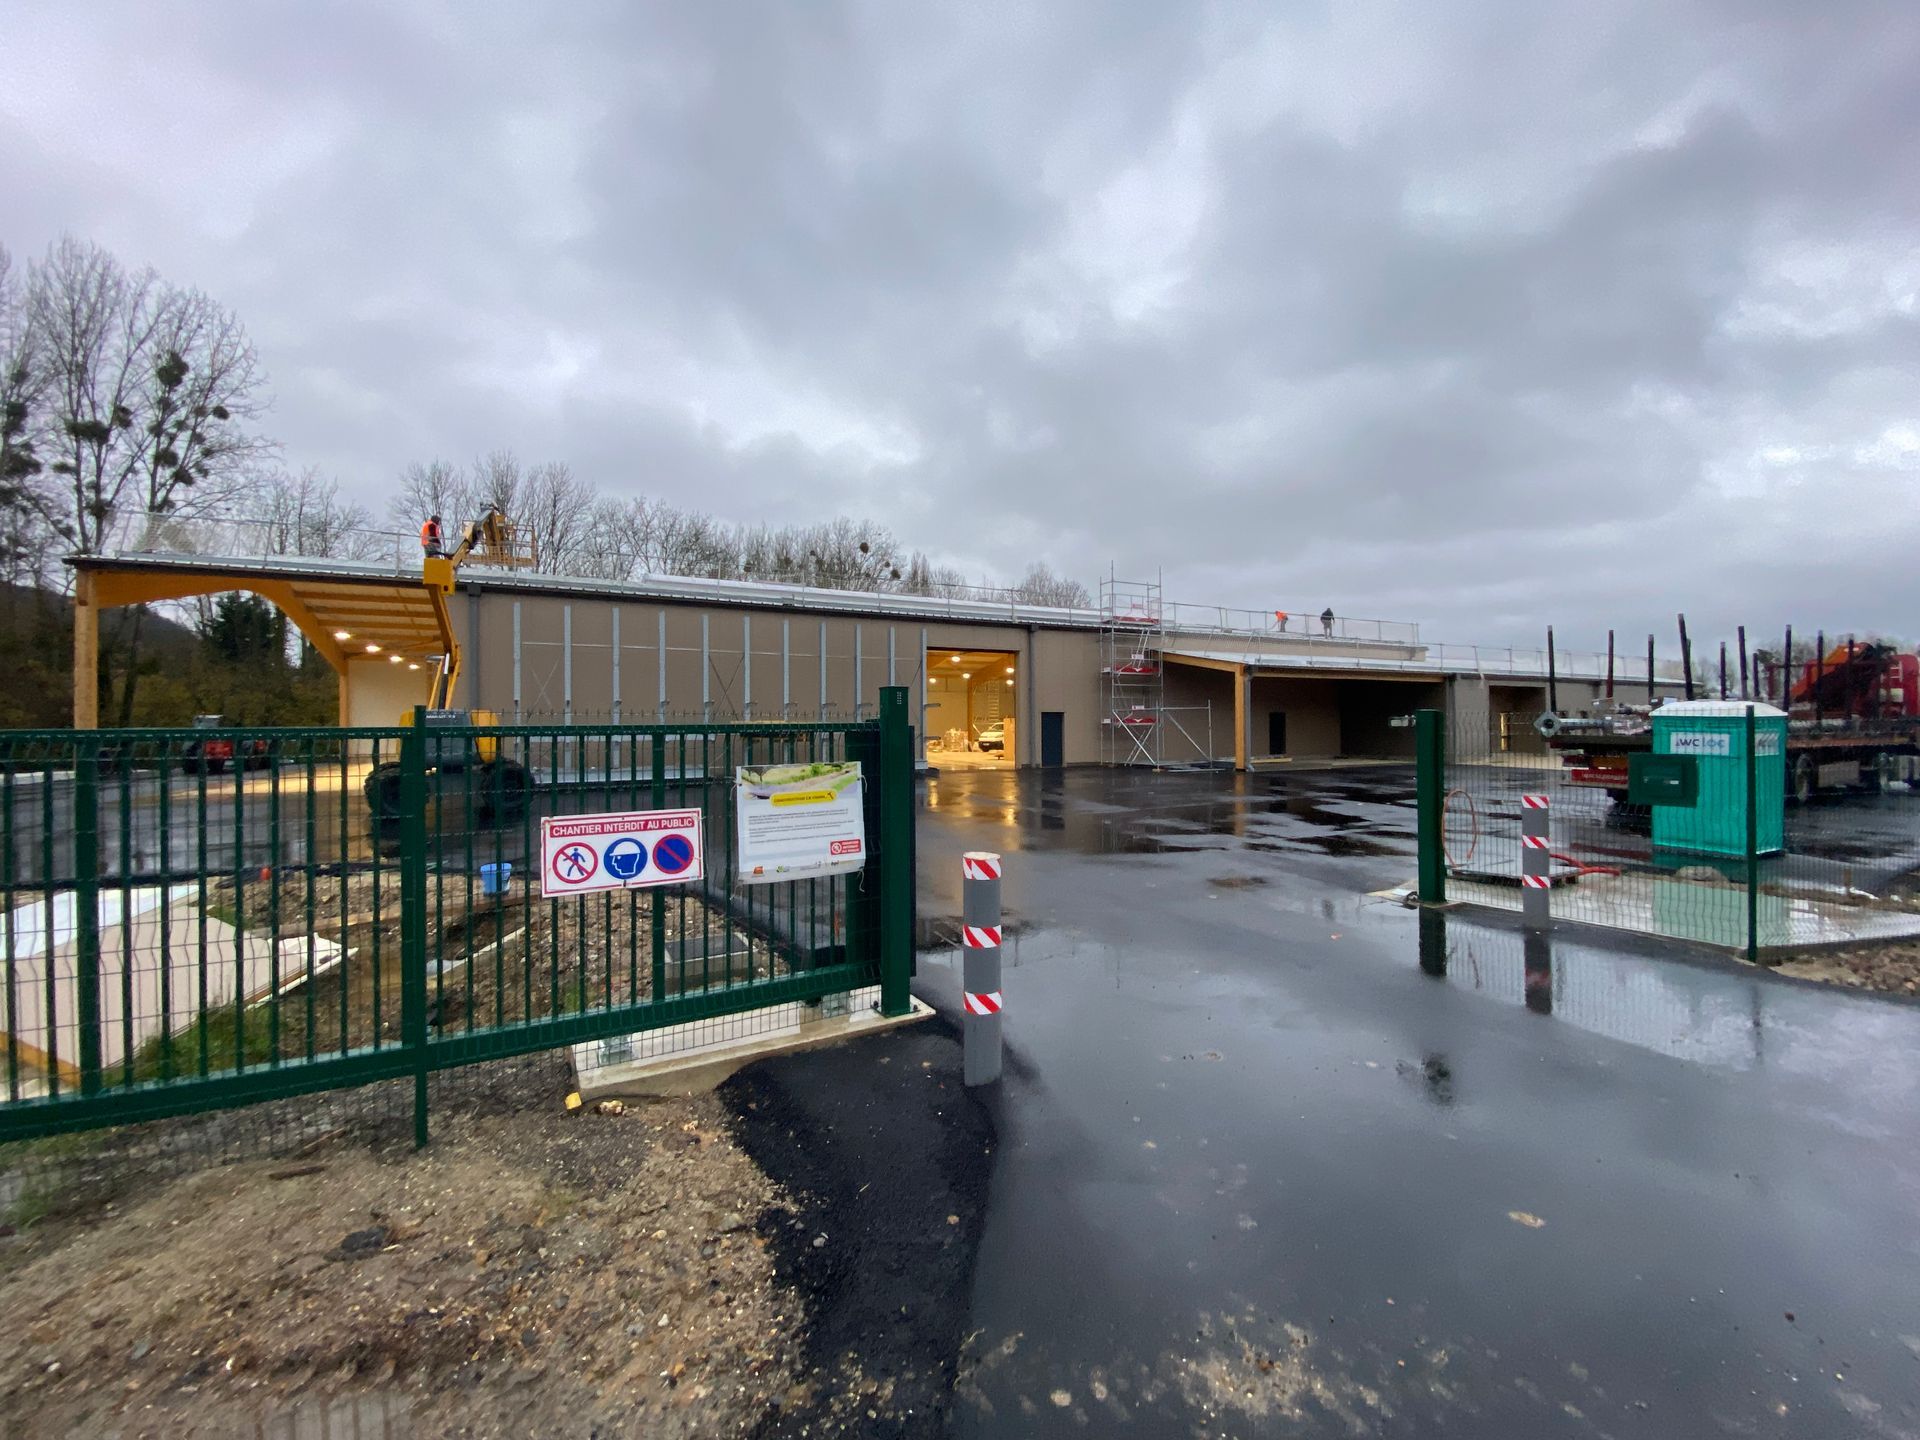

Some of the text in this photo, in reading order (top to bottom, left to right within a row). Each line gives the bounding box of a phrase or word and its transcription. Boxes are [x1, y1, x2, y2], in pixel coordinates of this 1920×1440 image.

[552, 817, 693, 836] CHANTIER INTERDIT AU PUBLIC
